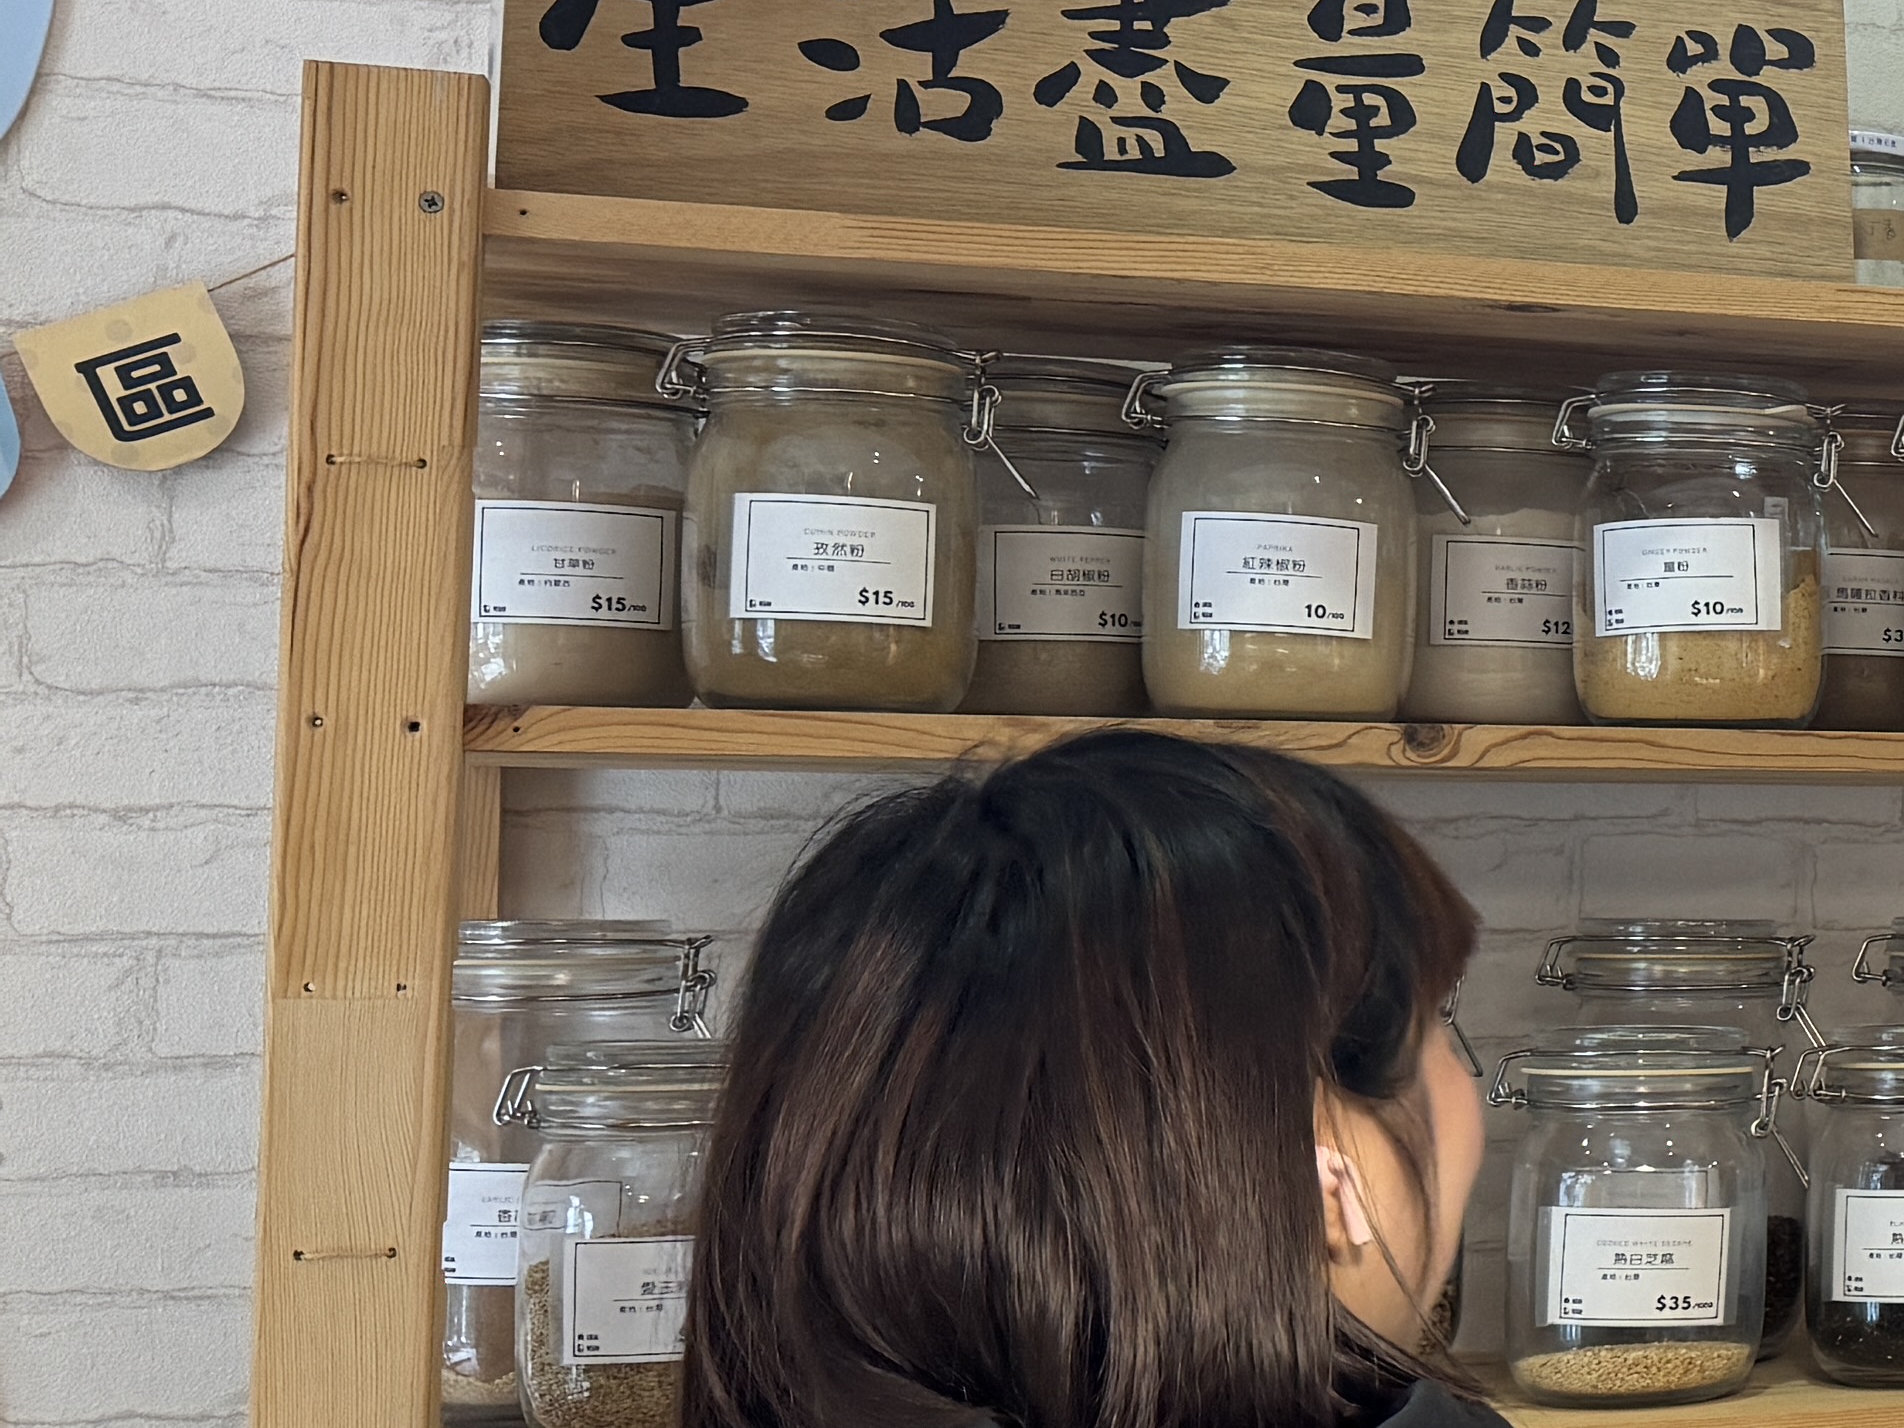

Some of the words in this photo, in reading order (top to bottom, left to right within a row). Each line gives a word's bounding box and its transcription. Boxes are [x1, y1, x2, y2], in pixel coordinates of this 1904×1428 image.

[74, 332, 215, 442] 區
[813, 542, 864, 558] 孜然粉
[1242, 556, 1306, 572] 紅辣椒粉
[1050, 569, 1110, 582] 白胡椒粉
